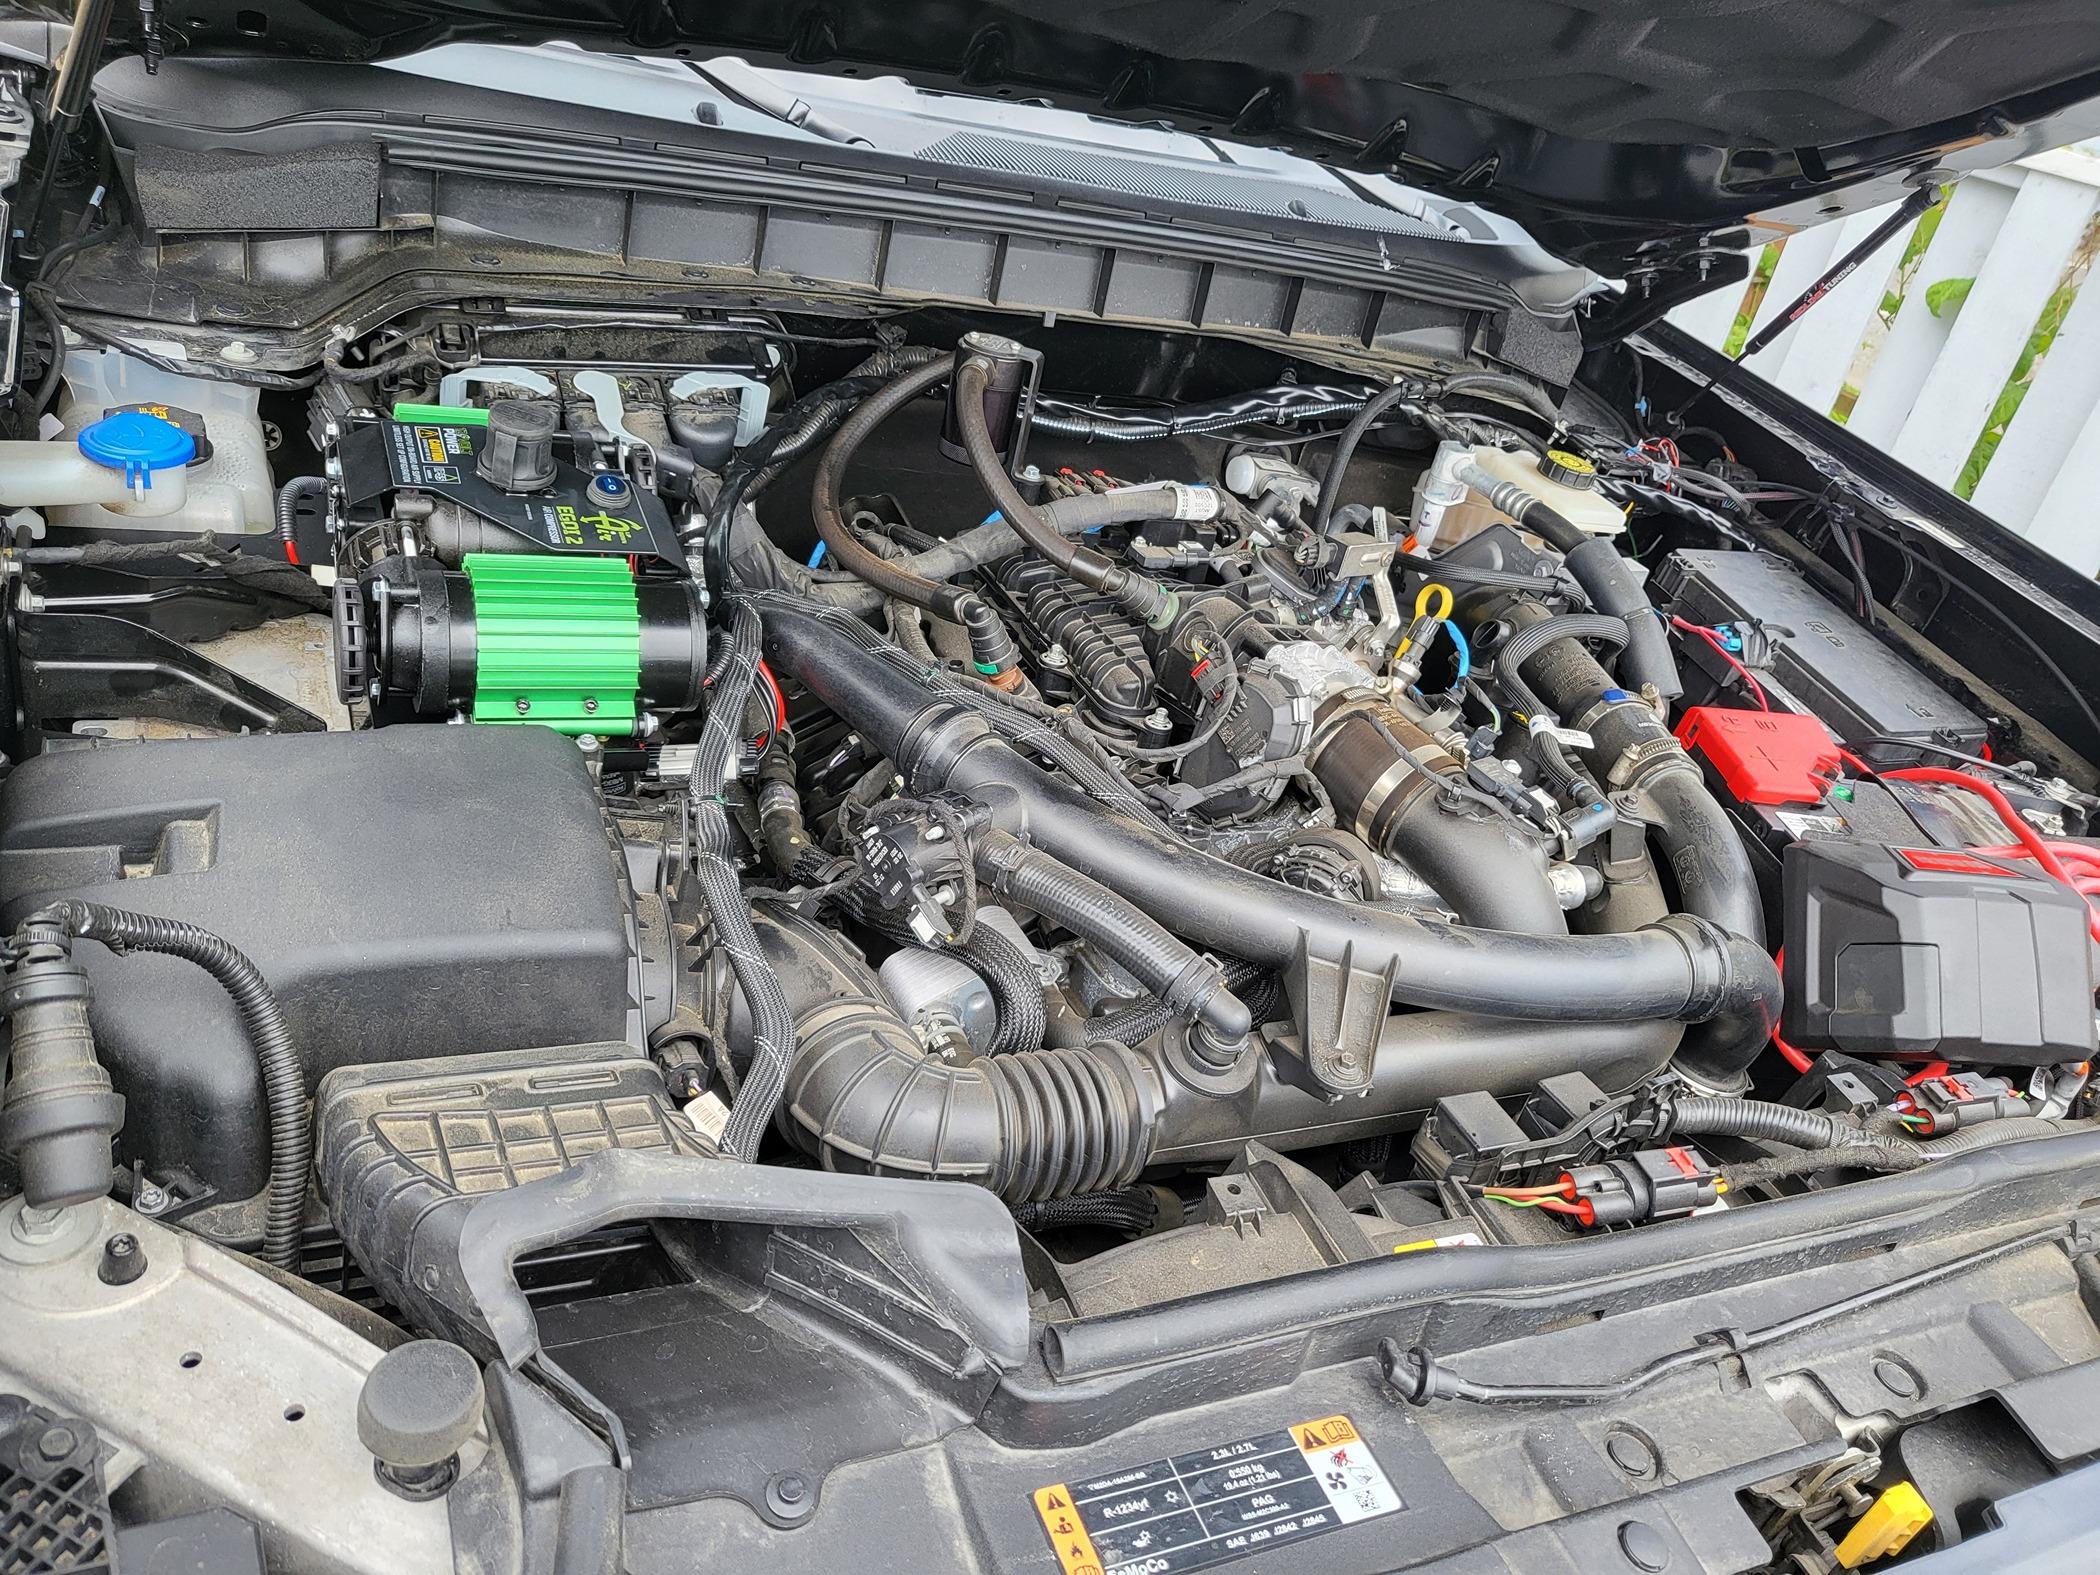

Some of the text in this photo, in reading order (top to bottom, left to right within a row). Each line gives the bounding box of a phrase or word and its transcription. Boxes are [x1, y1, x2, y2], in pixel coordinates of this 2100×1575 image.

[1823, 262, 1856, 290] TUNING
[442, 428, 460, 454] POWER
[544, 513, 560, 544] COMPRESSOR
[565, 536, 584, 545] 2
[1211, 1448, 1233, 1460] 2.3L
[1236, 1442, 1259, 1454] 2.7L
[1251, 1463, 1266, 1474] kg
[1103, 1497, 1150, 1519] R-1234yf
[1251, 1494, 1276, 1508] PAG
[1226, 1536, 1249, 1549] SAE
